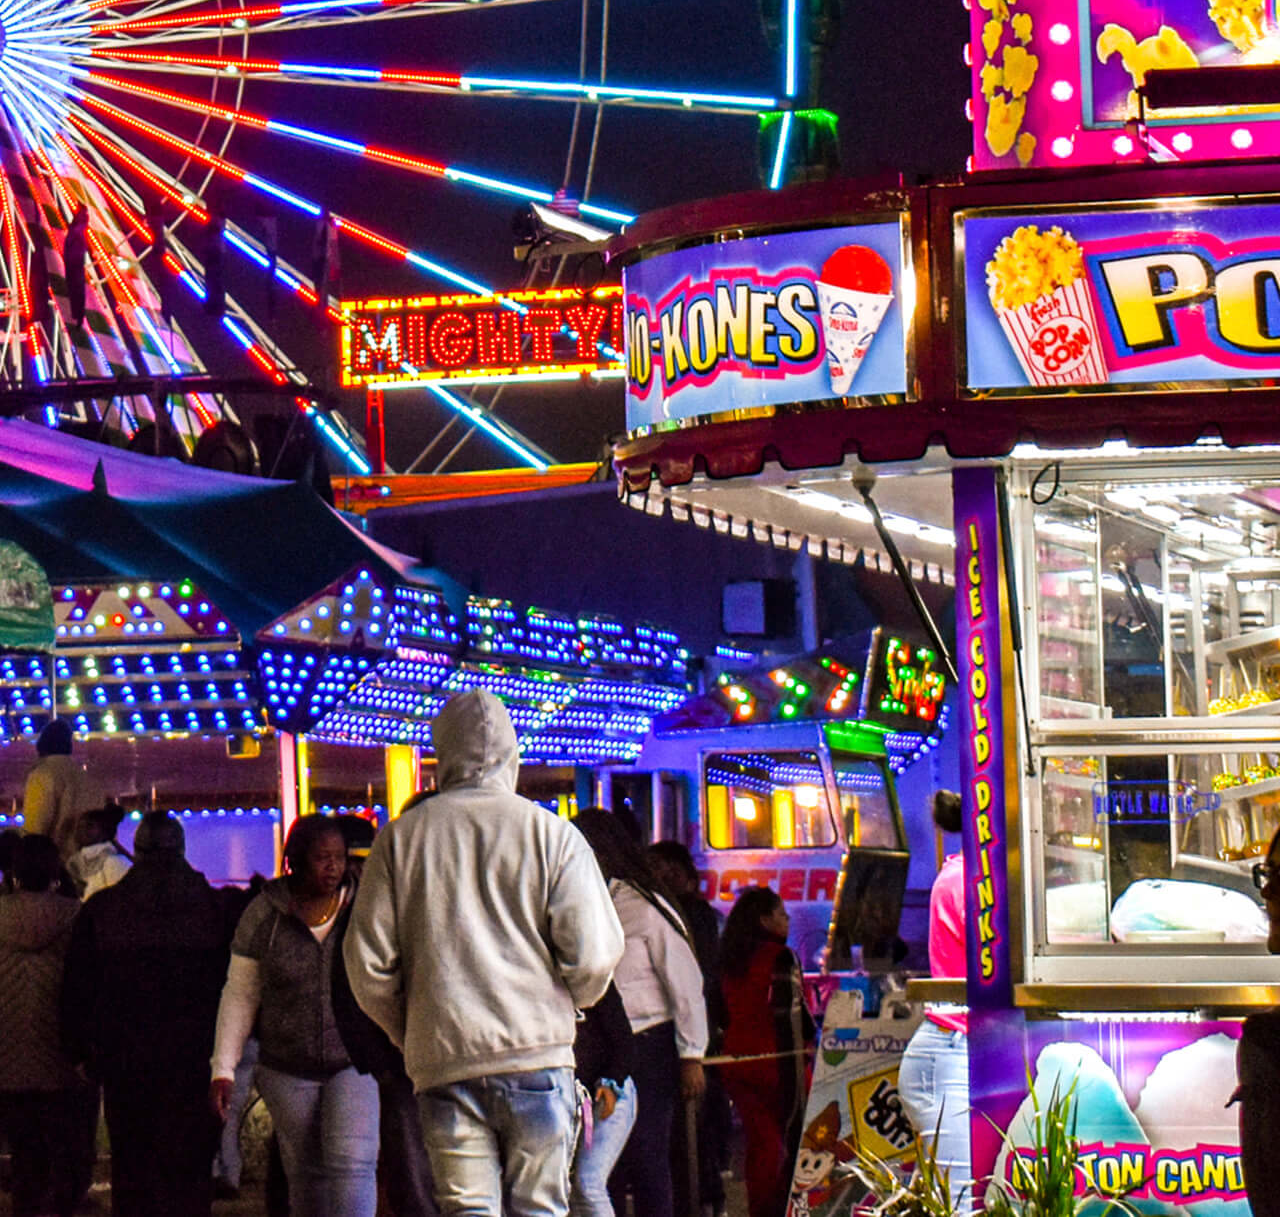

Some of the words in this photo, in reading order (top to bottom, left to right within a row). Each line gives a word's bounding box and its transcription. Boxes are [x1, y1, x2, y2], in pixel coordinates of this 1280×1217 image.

[354, 304, 608, 370] MIGHTY
[1031, 324, 1069, 357] POP
[1044, 327, 1090, 371] CORN
[968, 523, 983, 619] ICE
[971, 635, 990, 766] COLD
[975, 780, 995, 980] DRINKS
[1012, 1151, 1145, 1192] CTON
